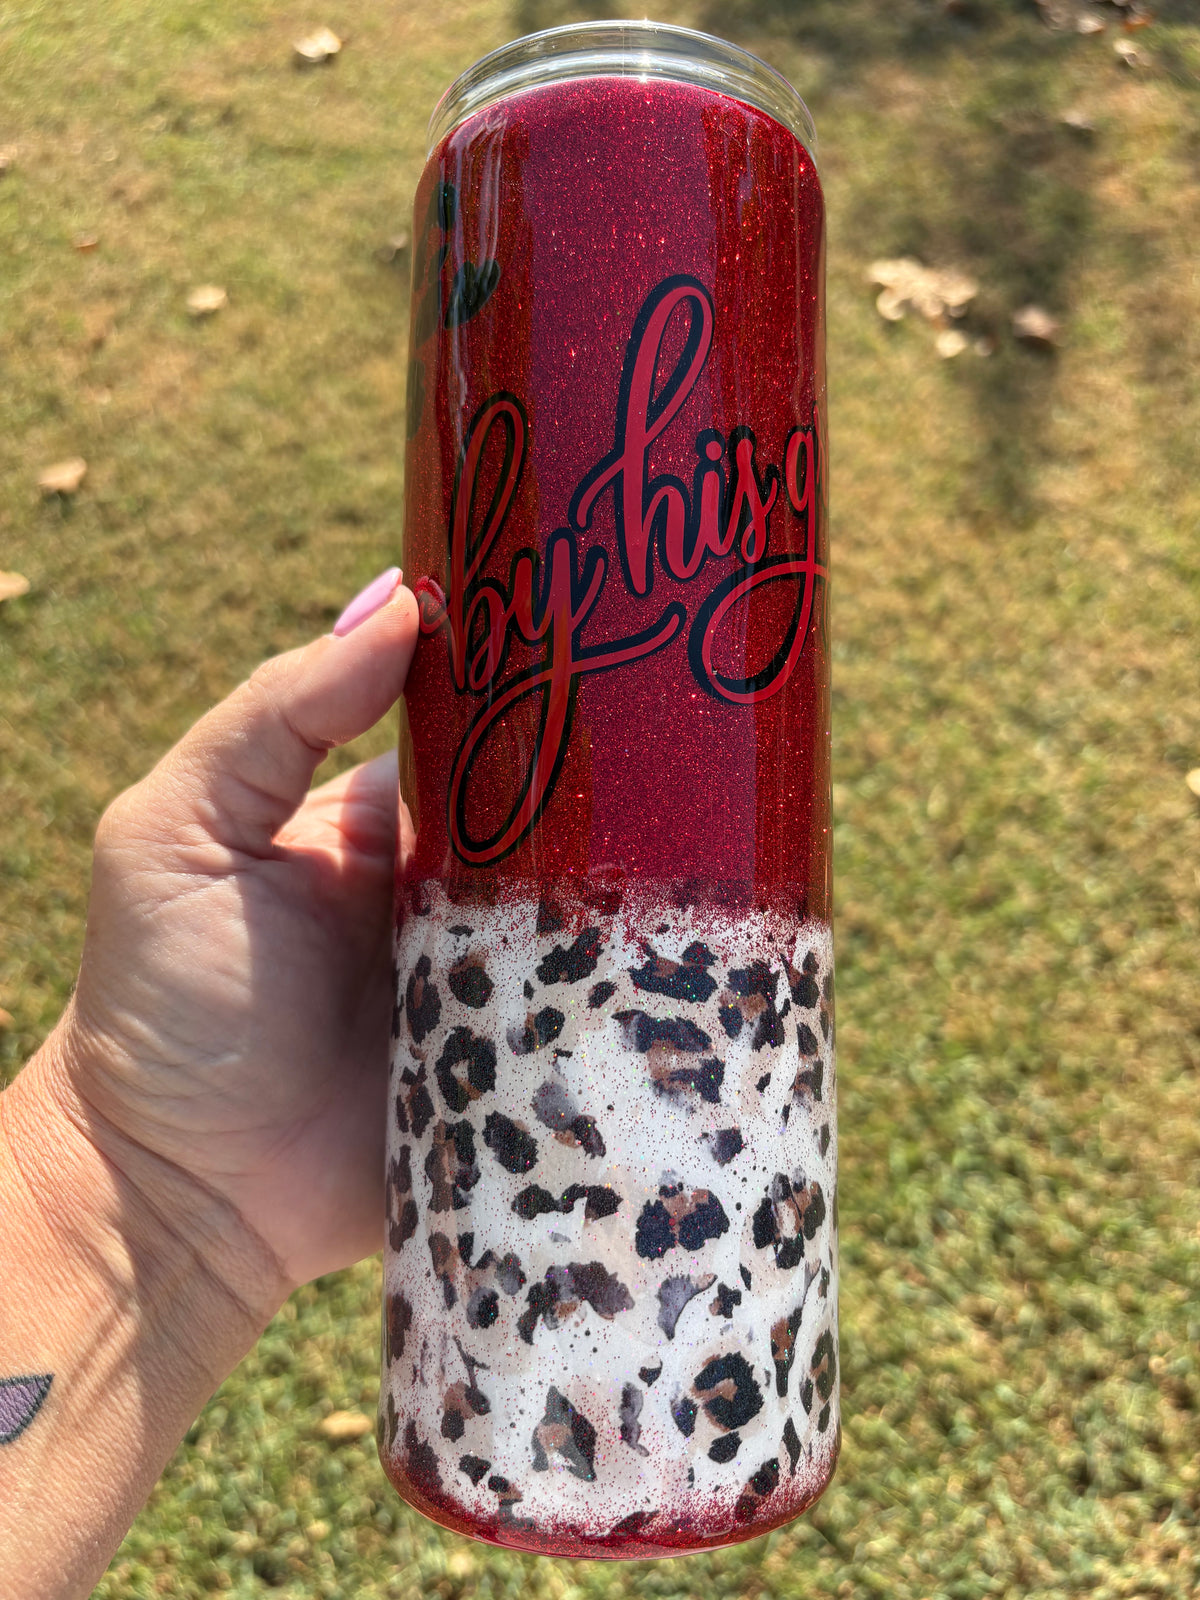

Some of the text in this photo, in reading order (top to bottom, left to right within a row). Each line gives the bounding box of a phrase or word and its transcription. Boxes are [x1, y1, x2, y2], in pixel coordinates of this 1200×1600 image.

[420, 274, 831, 866] by his g
